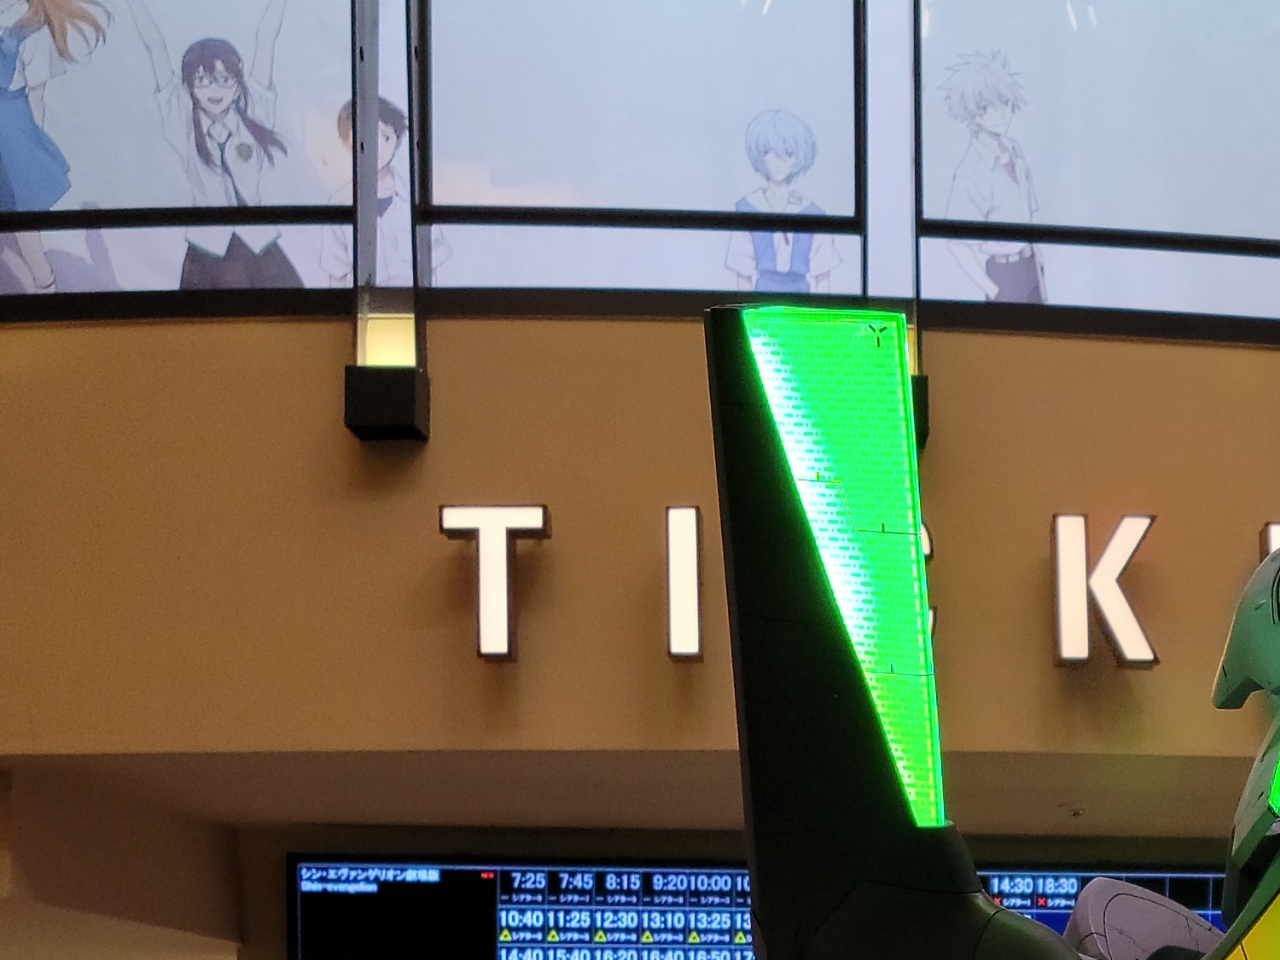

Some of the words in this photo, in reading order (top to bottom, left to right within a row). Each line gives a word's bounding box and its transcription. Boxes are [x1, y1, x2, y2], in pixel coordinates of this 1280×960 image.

[510, 872, 546, 889] 7:25
[558, 873, 593, 890] 7:45
[605, 873, 640, 891] 8:15
[652, 874, 687, 892] 9:20
[689, 875, 732, 893] 10:00
[991, 878, 1033, 894] 14:30
[1036, 878, 1078, 894] 18:30
[500, 911, 544, 927] 10:40
[547, 911, 591, 928] 11:25
[595, 912, 638, 929] 12:30
[642, 913, 685, 930] 13:10
[689, 913, 732, 931] 13:25
